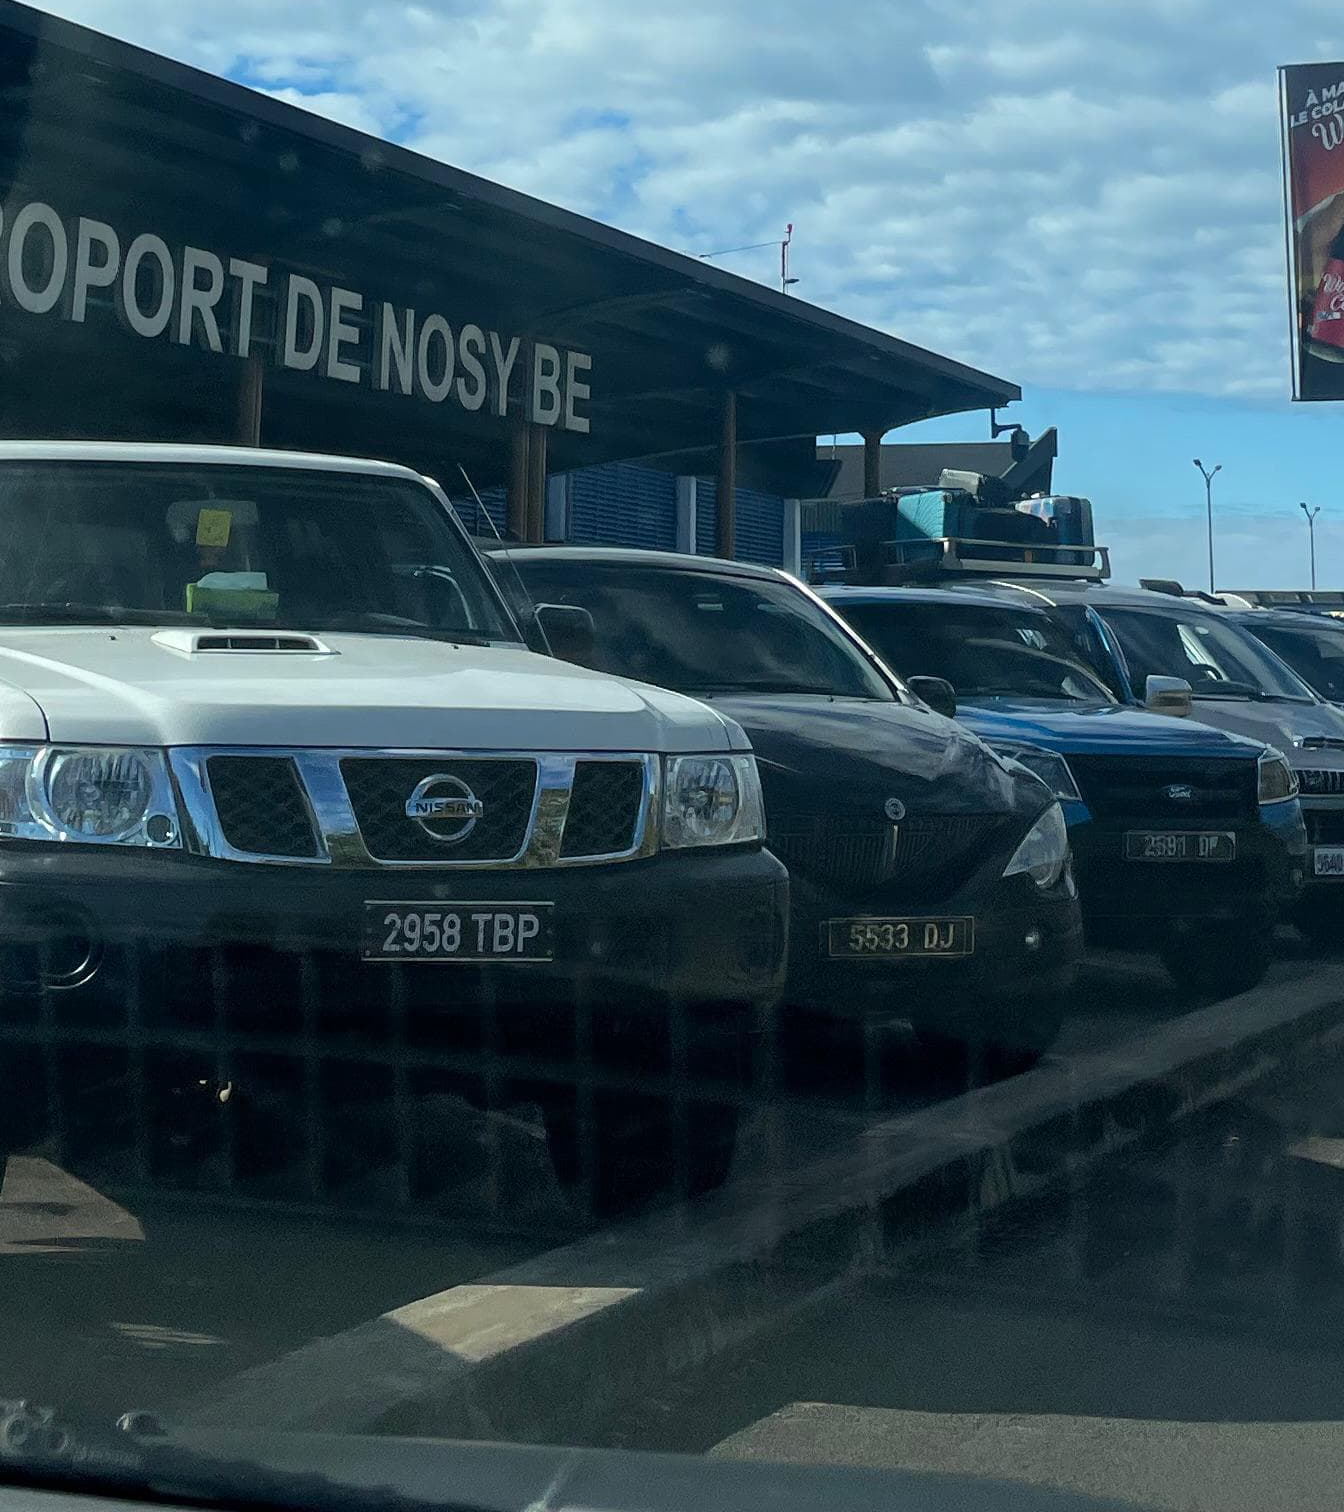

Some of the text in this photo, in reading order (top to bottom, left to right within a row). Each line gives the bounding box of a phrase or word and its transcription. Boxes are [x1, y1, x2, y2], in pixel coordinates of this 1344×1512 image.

[1306, 88, 1319, 107] À
[1290, 110, 1308, 128] LE
[284, 273, 362, 383] DE
[378, 302, 521, 418] NOSY
[531, 342, 593, 434] BE
[415, 801, 480, 815] NISSAN
[382, 913, 540, 953] 2958 TBP
[849, 923, 954, 952] 5533 DJ
